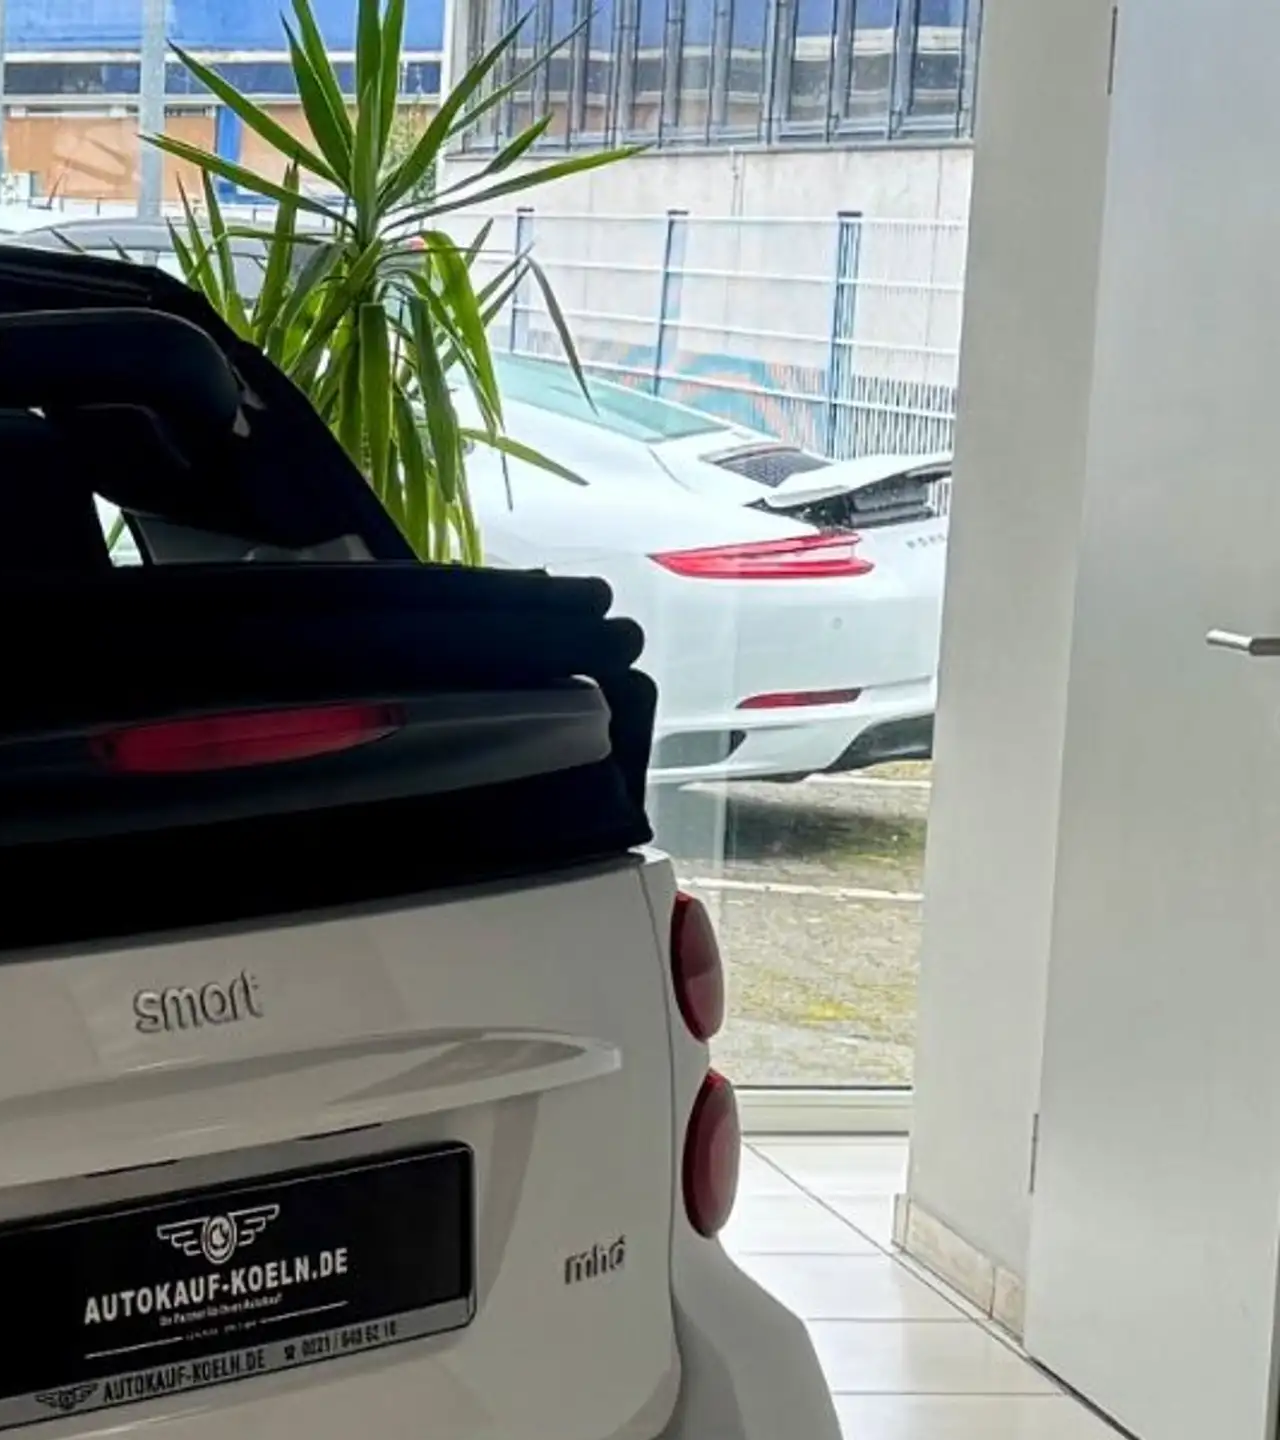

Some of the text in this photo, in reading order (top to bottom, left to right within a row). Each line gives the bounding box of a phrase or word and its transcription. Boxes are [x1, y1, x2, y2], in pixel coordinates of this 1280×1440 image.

[133, 969, 264, 1033] smart
[84, 1247, 348, 1326] AUTOKAUF-KOELN.DE
[564, 1233, 627, 1286] mhd
[104, 1349, 265, 1403] AUTOKAUF-KOELN.DE
